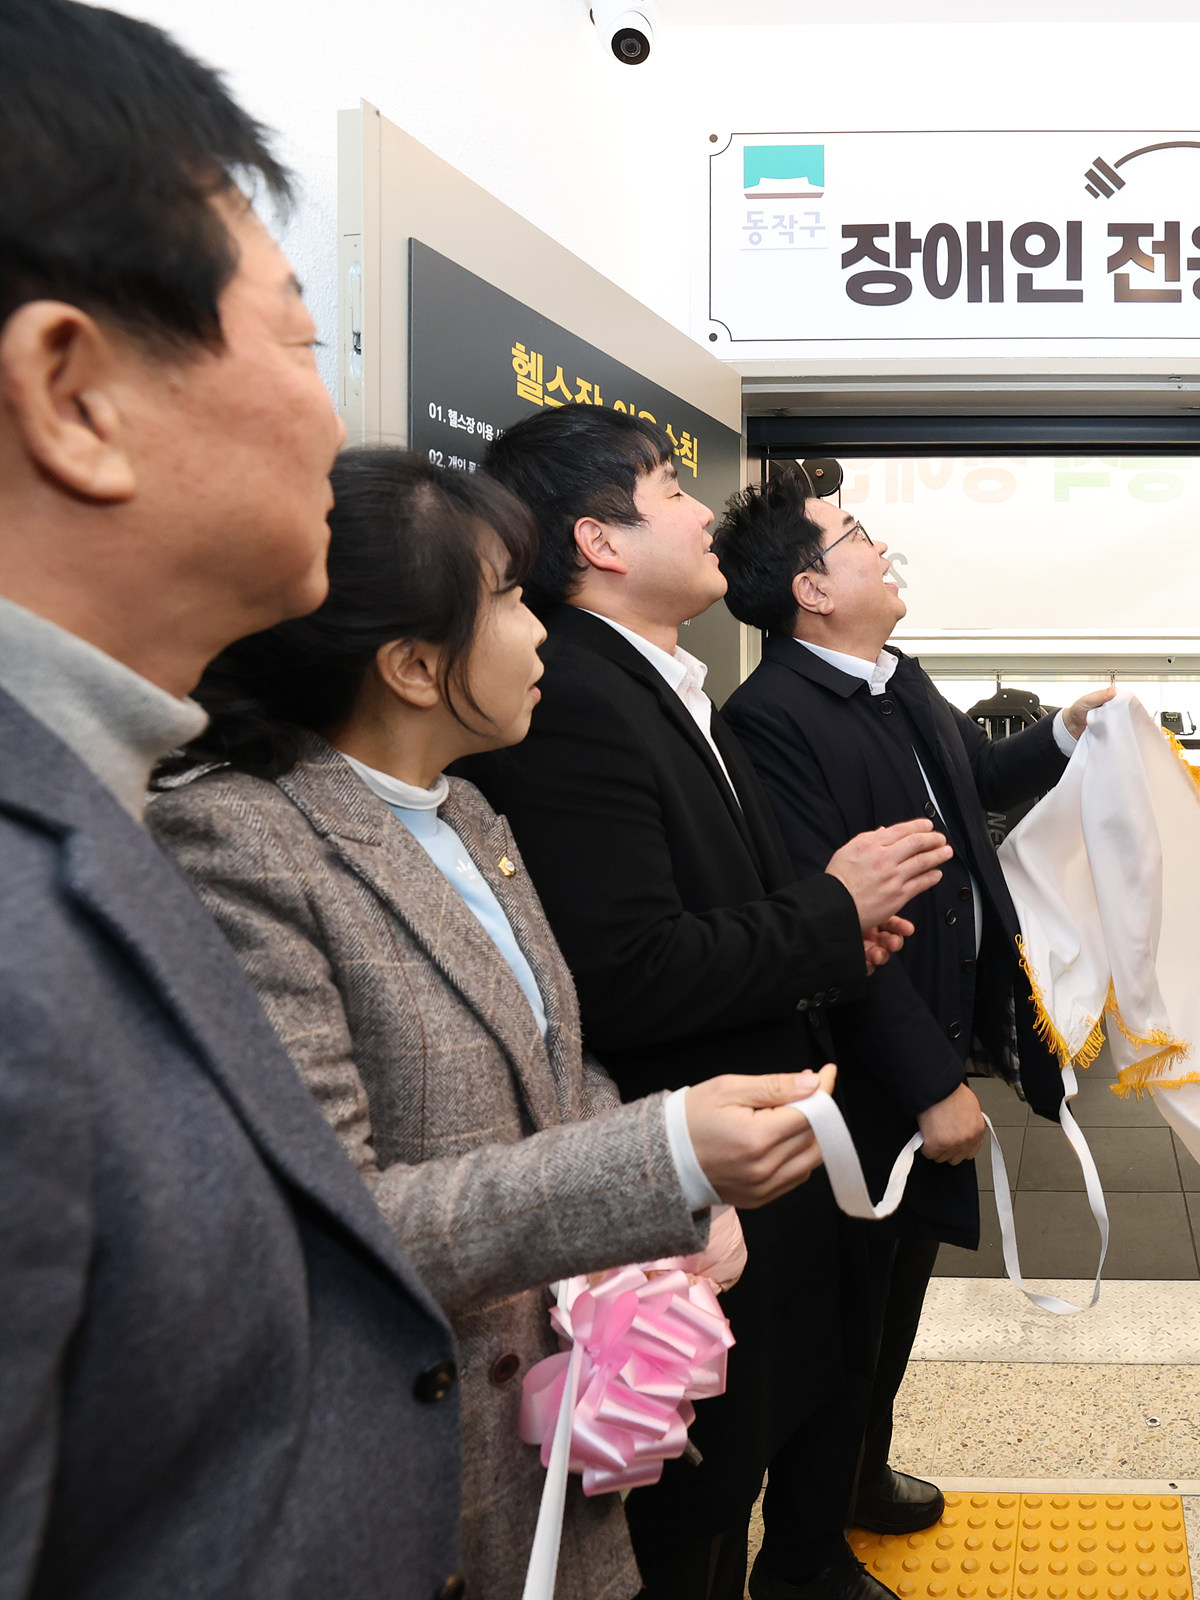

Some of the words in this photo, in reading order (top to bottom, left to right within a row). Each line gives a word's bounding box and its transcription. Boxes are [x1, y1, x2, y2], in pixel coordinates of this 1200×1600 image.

[742, 211, 826, 246] 동작구
[841, 220, 1084, 307] 장애인
[428, 402, 447, 424] 01.
[447, 408, 475, 435] 헬스장
[476, 421, 494, 442] 이용
[428, 448, 447, 469] 02.
